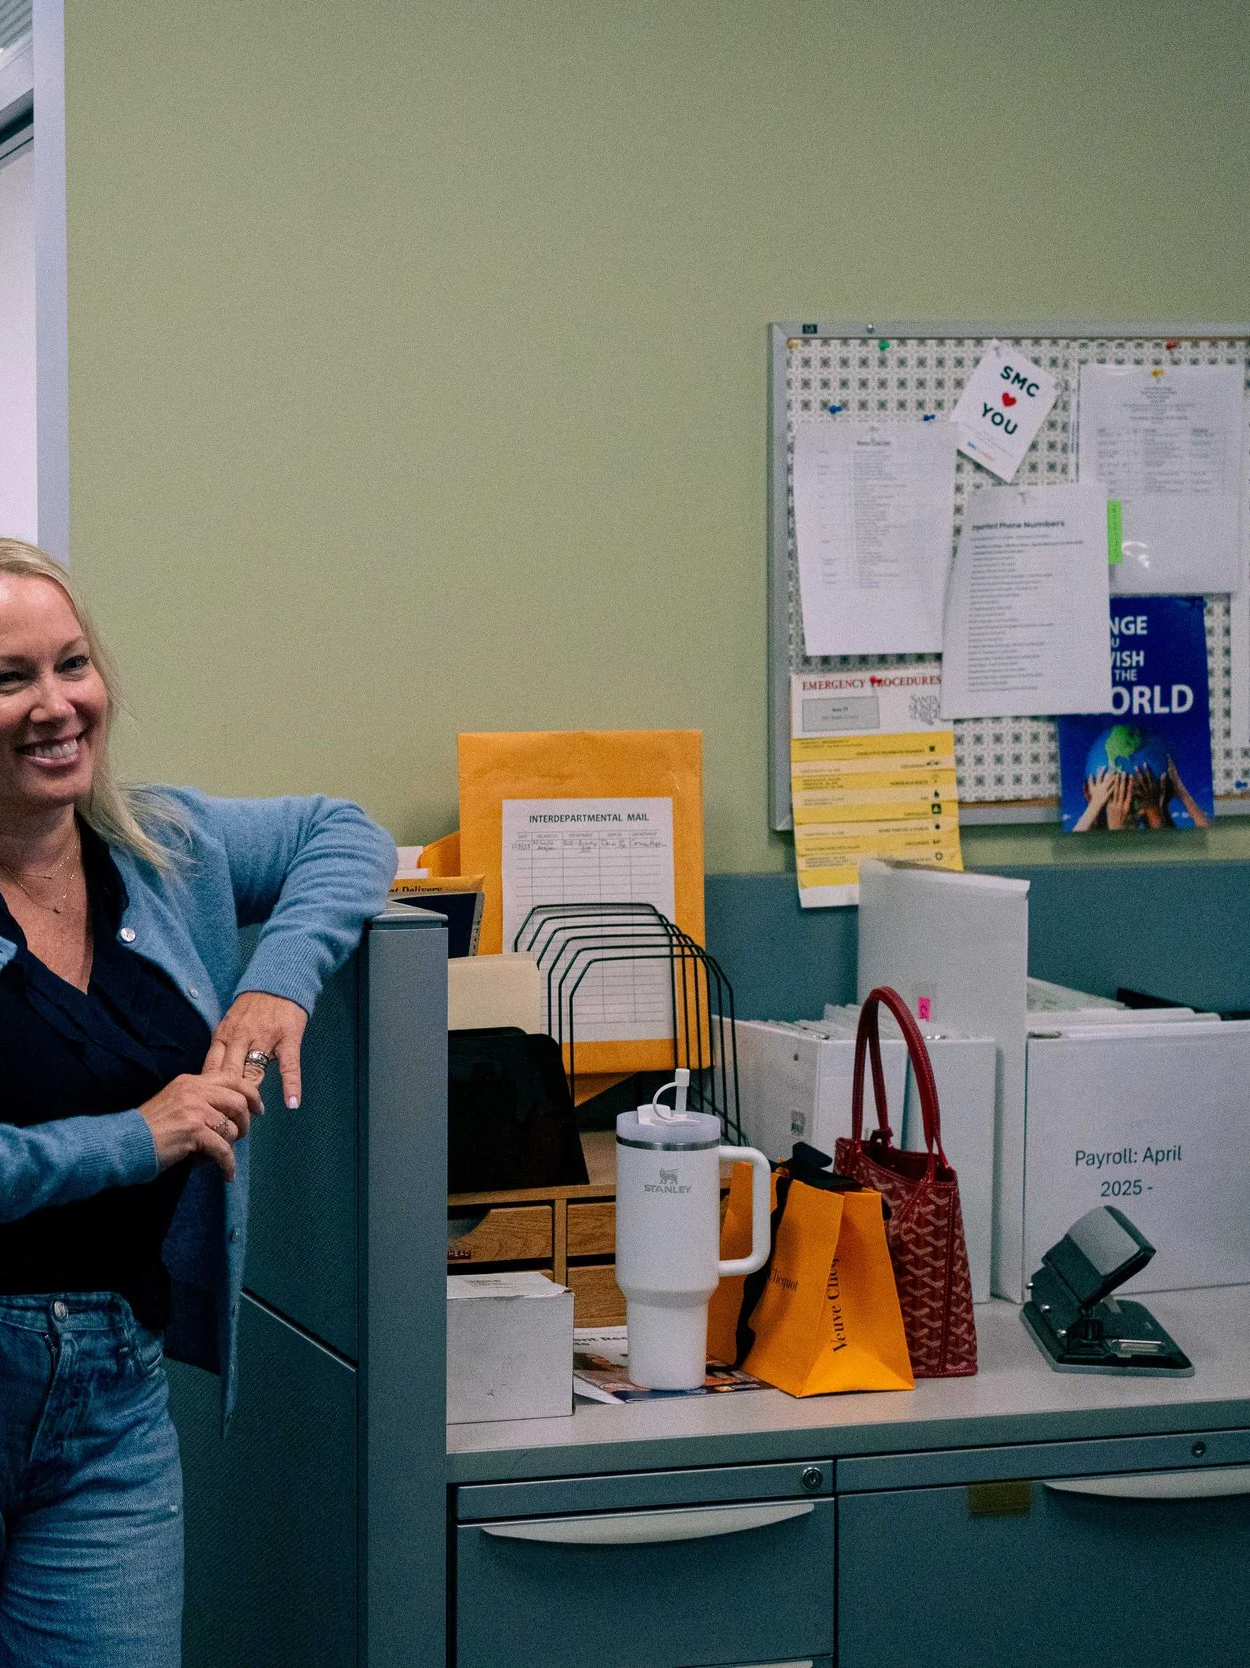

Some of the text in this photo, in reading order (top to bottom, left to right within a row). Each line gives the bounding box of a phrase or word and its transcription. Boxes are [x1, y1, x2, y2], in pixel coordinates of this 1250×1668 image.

[1000, 365, 1040, 398] SMC
[982, 402, 1018, 435] YOU
[1023, 520, 1065, 528] Numbers
[1114, 668, 1138, 682] THE
[802, 679, 865, 691] EMERGENCY
[529, 813, 650, 823] INTERDEPARTMENTAL MAIL
[1075, 1145, 1182, 1169] Payroll: April
[644, 1184, 692, 1193] STANLEY
[1100, 1179, 1143, 1197] 2025
[831, 1304, 848, 1352] Veuve
